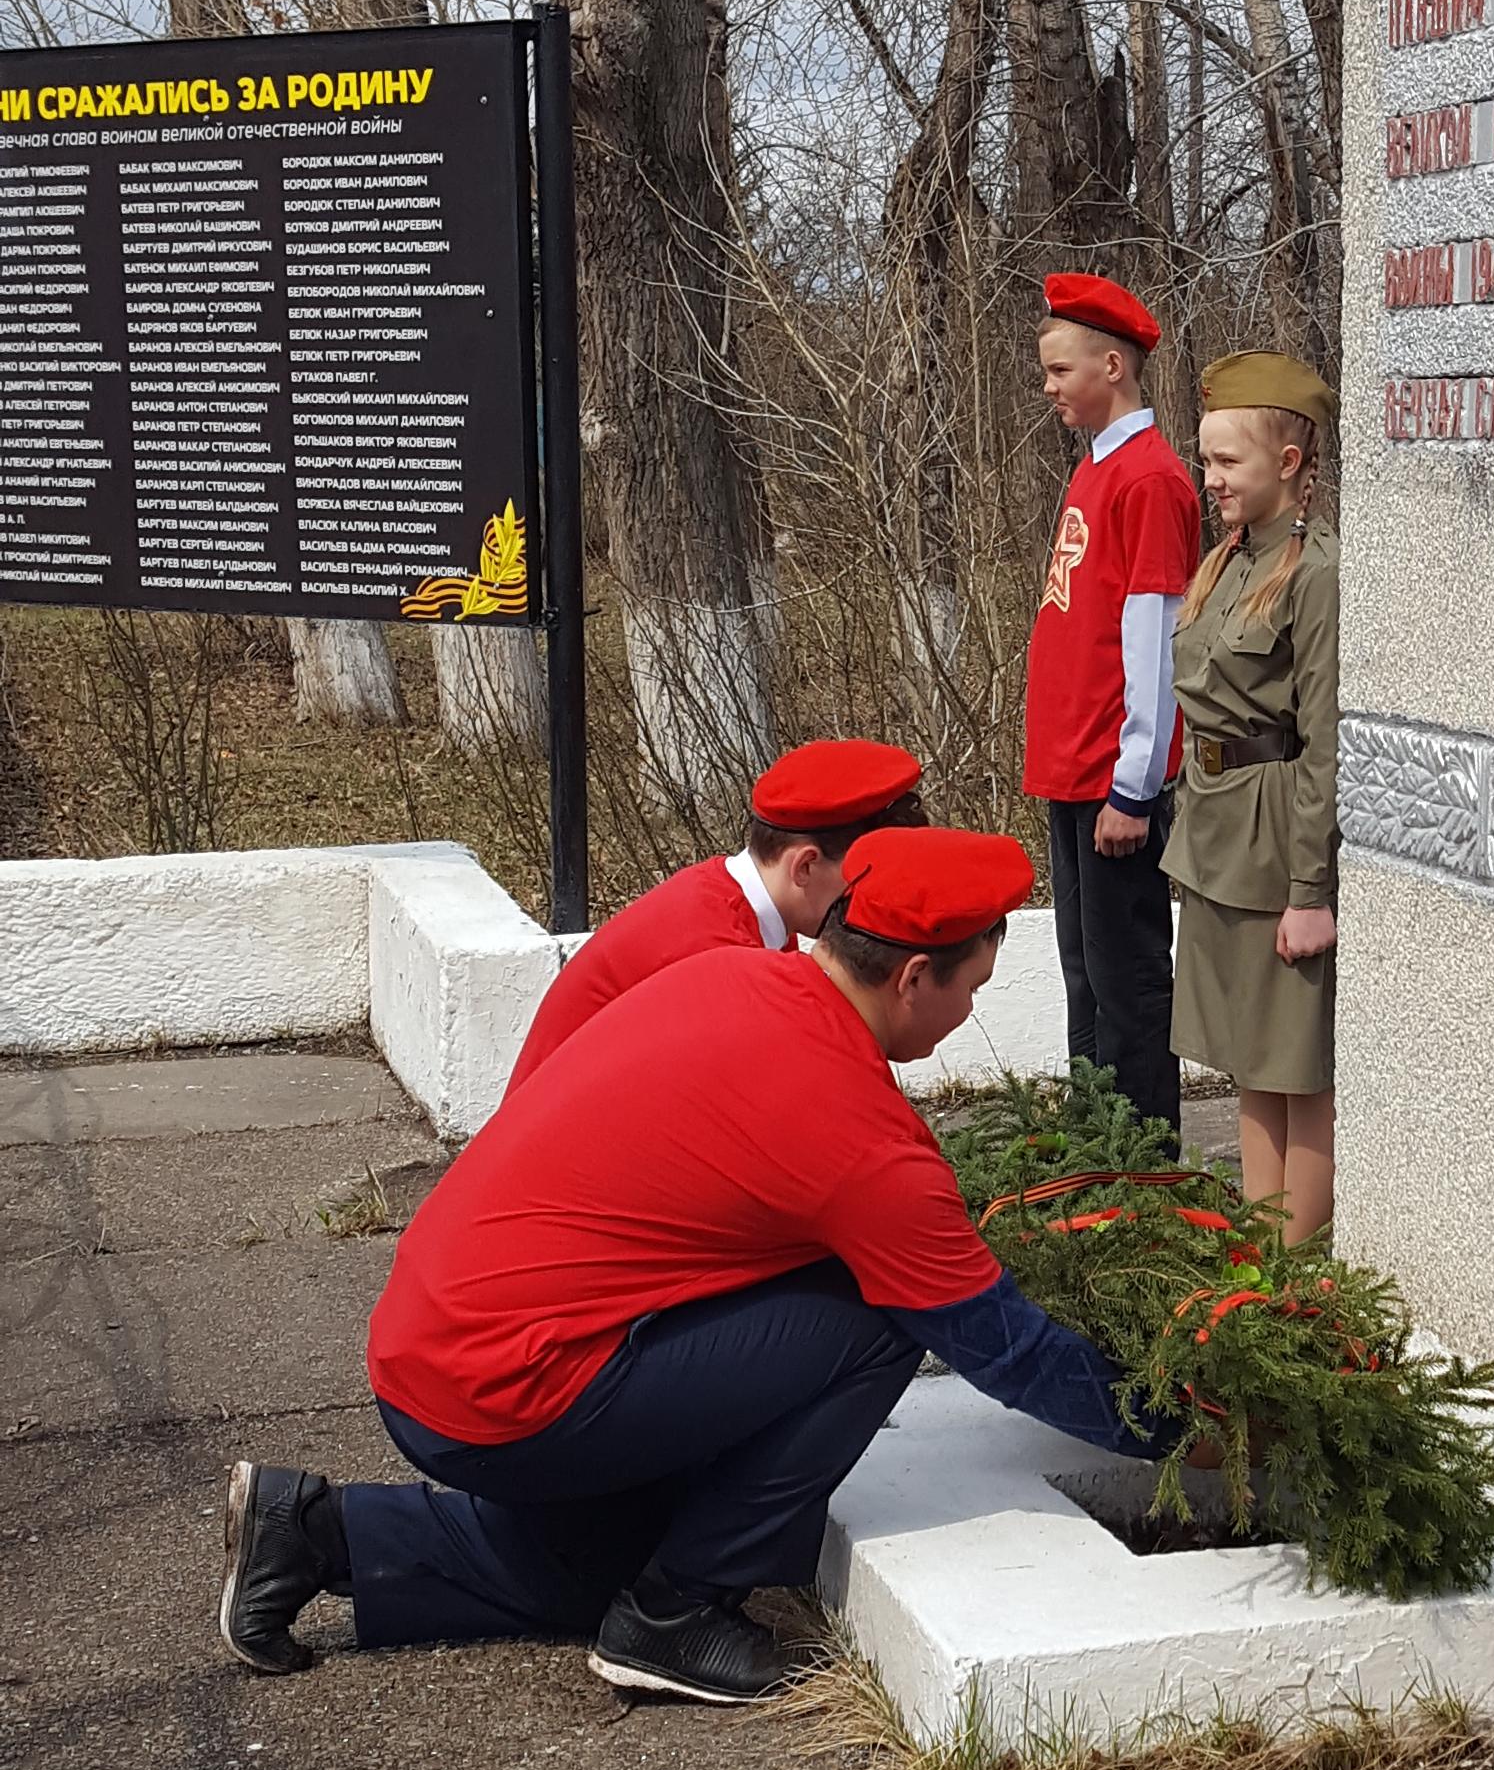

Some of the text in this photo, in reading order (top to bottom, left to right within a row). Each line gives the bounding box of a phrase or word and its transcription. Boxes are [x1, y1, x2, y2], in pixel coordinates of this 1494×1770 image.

[38, 79, 230, 120] СРАЖАЛИСЬ
[237, 76, 280, 111] ЗА
[287, 68, 434, 111] РОДИНУ
[52, 132, 97, 147] слава
[101, 130, 157, 145] воинам
[161, 122, 223, 143] великой
[227, 116, 346, 140] отечественной
[350, 115, 402, 135] войны
[119, 160, 243, 174] БАБАК ЯКОВ МАКСИМОВИЧ
[282, 153, 443, 169] БОРОДЮК МАКСИМ ДАНИЛОВИЧ
[120, 180, 258, 194] БАБАК МИХАИЛ МАКСИМОВИЧ
[283, 175, 428, 190] БОРОДЮК ИВАН ДАНИЛОВИЧ
[121, 201, 245, 214] БАТЕЕВ ПЕТР ГРИГОРЬЕВИЧ
[284, 197, 441, 211] БОРОДЮК СТЕПАН ДАНИЛОВИЧ
[122, 223, 156, 233] БАТЕЕВ
[157, 222, 202, 233] НИКОЛАЙ
[285, 219, 442, 233] БОТЯКОВ ДМИТРИЙ АНДРЕЕВИЧ
[171, 242, 216, 253] ДМИТРИЙ
[348, 242, 382, 253] БОРИС
[383, 241, 450, 253] ВАСИЛЬЕВИЧ
[167, 262, 208, 273] МИХАИЛ
[208, 261, 259, 272] ЕФИМОВИЧ
[286, 263, 431, 276] БЕЗГУБОВ ПЕТР НИКОЛАЕВИЧ
[165, 282, 220, 293] АЛЕКСАНДР
[221, 281, 275, 292] ЯКОВЛЕВИЧ
[287, 285, 485, 297] БЕЛОБОРОДОВ НИКОЛАЙ МИХАЙЛОВИЧ
[172, 303, 207, 313] ДОМНА
[288, 307, 422, 318] БЕЛЮК ИВАН ГРИГОРЬЕВИЧ
[179, 322, 204, 332] ЯКОВ
[205, 322, 257, 332] БАРГУЕВИЧ
[289, 329, 428, 339] БЕЛЮК НАЗАР ГРИГОРЬЕВИЧ
[128, 342, 282, 352] БАРАНОВ АЛЕКСЕЙ ЕМЕЛЬЯНОВИЧ
[290, 351, 421, 361] БЕЛЮК ПЕТР ГРИГОРЬЕВИЧ
[129, 362, 266, 372] БАРАНОВ ИВАН ЕМЕЛЬЯНОВИЧ
[291, 372, 334, 382] БУТАКОВ
[335, 372, 368, 382] ПАВЕЛ
[130, 382, 280, 393] БАРАНОВ АЛЕКСЕЙ АНИСИМОВИЧ
[292, 393, 469, 405] БЫКОВСКИЙ МИХАИЛ МИХАЙЛОВИЧ
[131, 401, 268, 413] БАРАНОВ АНТОН СТЕПАНОВИЧ
[132, 421, 261, 433] БАРАНОВ ПЕТР СТЕПАНОВИЧ
[293, 414, 465, 427] БОГОМОЛОВ МИХАИЛ ДАНИЛОВИЧ
[133, 440, 271, 453] БАРАНОВ МАКАР СТЕПАНОВИЧ
[294, 435, 457, 448] БОЛЬШАКОВ ВИКТОР ЯКОВЛЕВИЧ
[134, 460, 286, 473] БАРАНОВ ВАСИЛИЙ АНИСИМОВИЧ
[295, 456, 462, 470] БОНДАРЧУК АНДРЕЙ АЛЕКСЕЕВИЧ
[135, 479, 265, 492] БАРАНОВ КАРП СТЕПАНОВИЧ
[296, 477, 462, 491] ВИНОГРАДОВ ИВАН МИХАЙЛОВИЧ
[136, 499, 177, 509] БАРГУЕВ
[178, 500, 214, 511] МАТВЕЙ
[343, 500, 395, 511] ВЯЧЕСЛАВ
[137, 518, 269, 532] БАРГУЕВ МАКСИМ ИВАНОВИЧ
[298, 519, 437, 533] ВЛАСЮК КАЛИНА ВЛАСОВИЧ
[138, 537, 264, 552] БАРГУЕВ СЕРГЕЙ ИВАНОВИЧ
[299, 540, 451, 555] ВАСИЛЬЕВ БАДМА РОМАНОВИЧ
[140, 557, 180, 568] БАРГУЕВ
[180, 558, 211, 569] ПАВЕЛ
[300, 561, 468, 577] ВАСИЛЬЕВ ГЕННАДИЙ РОМАНОВИЧ
[141, 576, 292, 592] БАЖЕНОВ МИХАИЛ ЕМЕЛЬЯНОВИЧ
[301, 582, 350, 594] ВАСИЛЬЕВ
[351, 584, 398, 596] ВАСИЛИЙ
